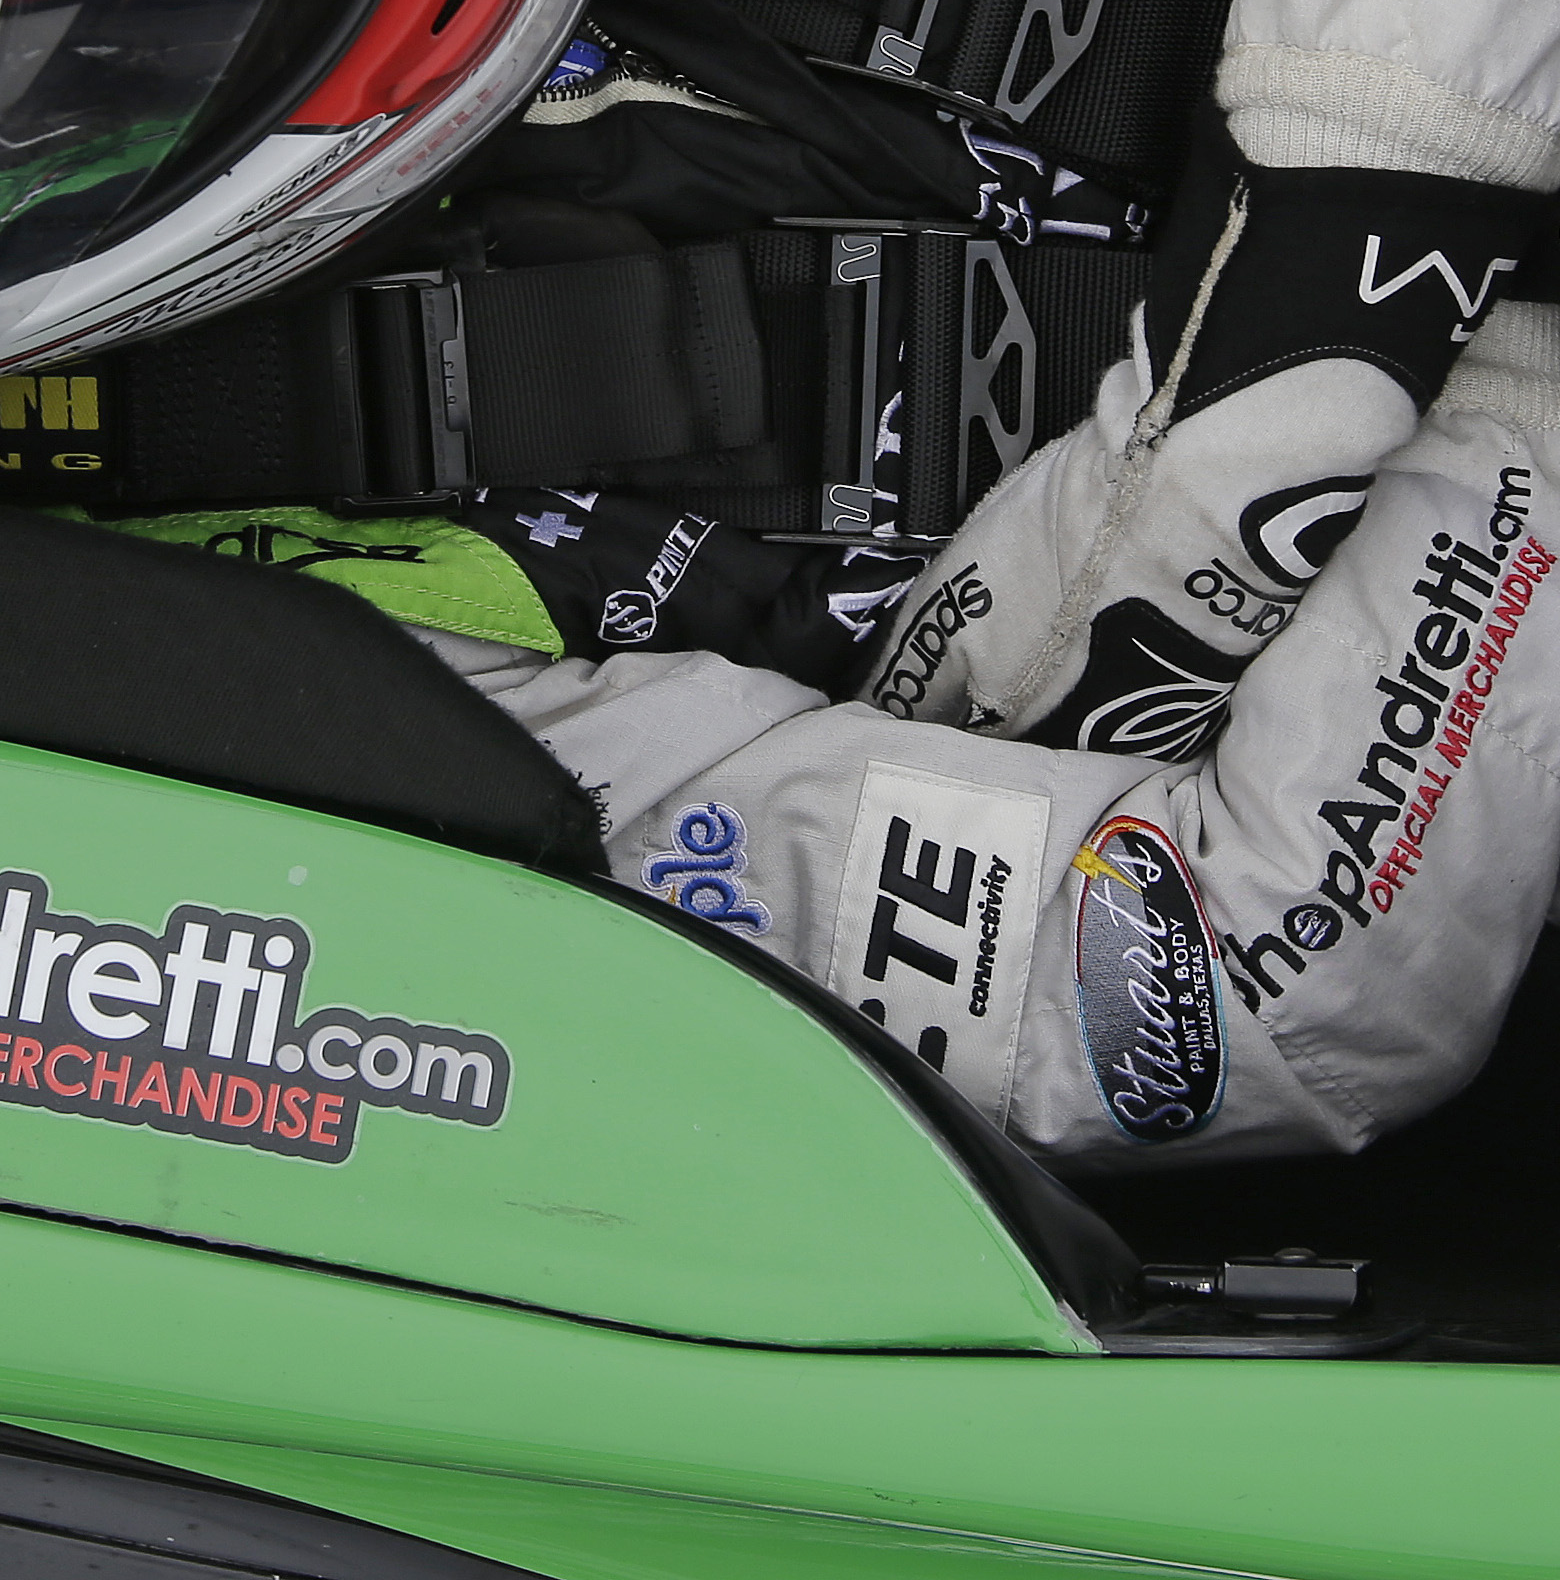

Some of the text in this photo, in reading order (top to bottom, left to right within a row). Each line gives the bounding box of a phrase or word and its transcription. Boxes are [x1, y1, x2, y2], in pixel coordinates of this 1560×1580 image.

[646, 510, 709, 599] PINT
[1184, 566, 1291, 638] arco
[865, 814, 977, 986] TE
[1367, 767, 1451, 914] OFFICIAL
[969, 851, 1012, 1020] connectivity
[1091, 843, 1195, 1129] Stuart's
[1169, 917, 1205, 1073] PAINT & BODY
